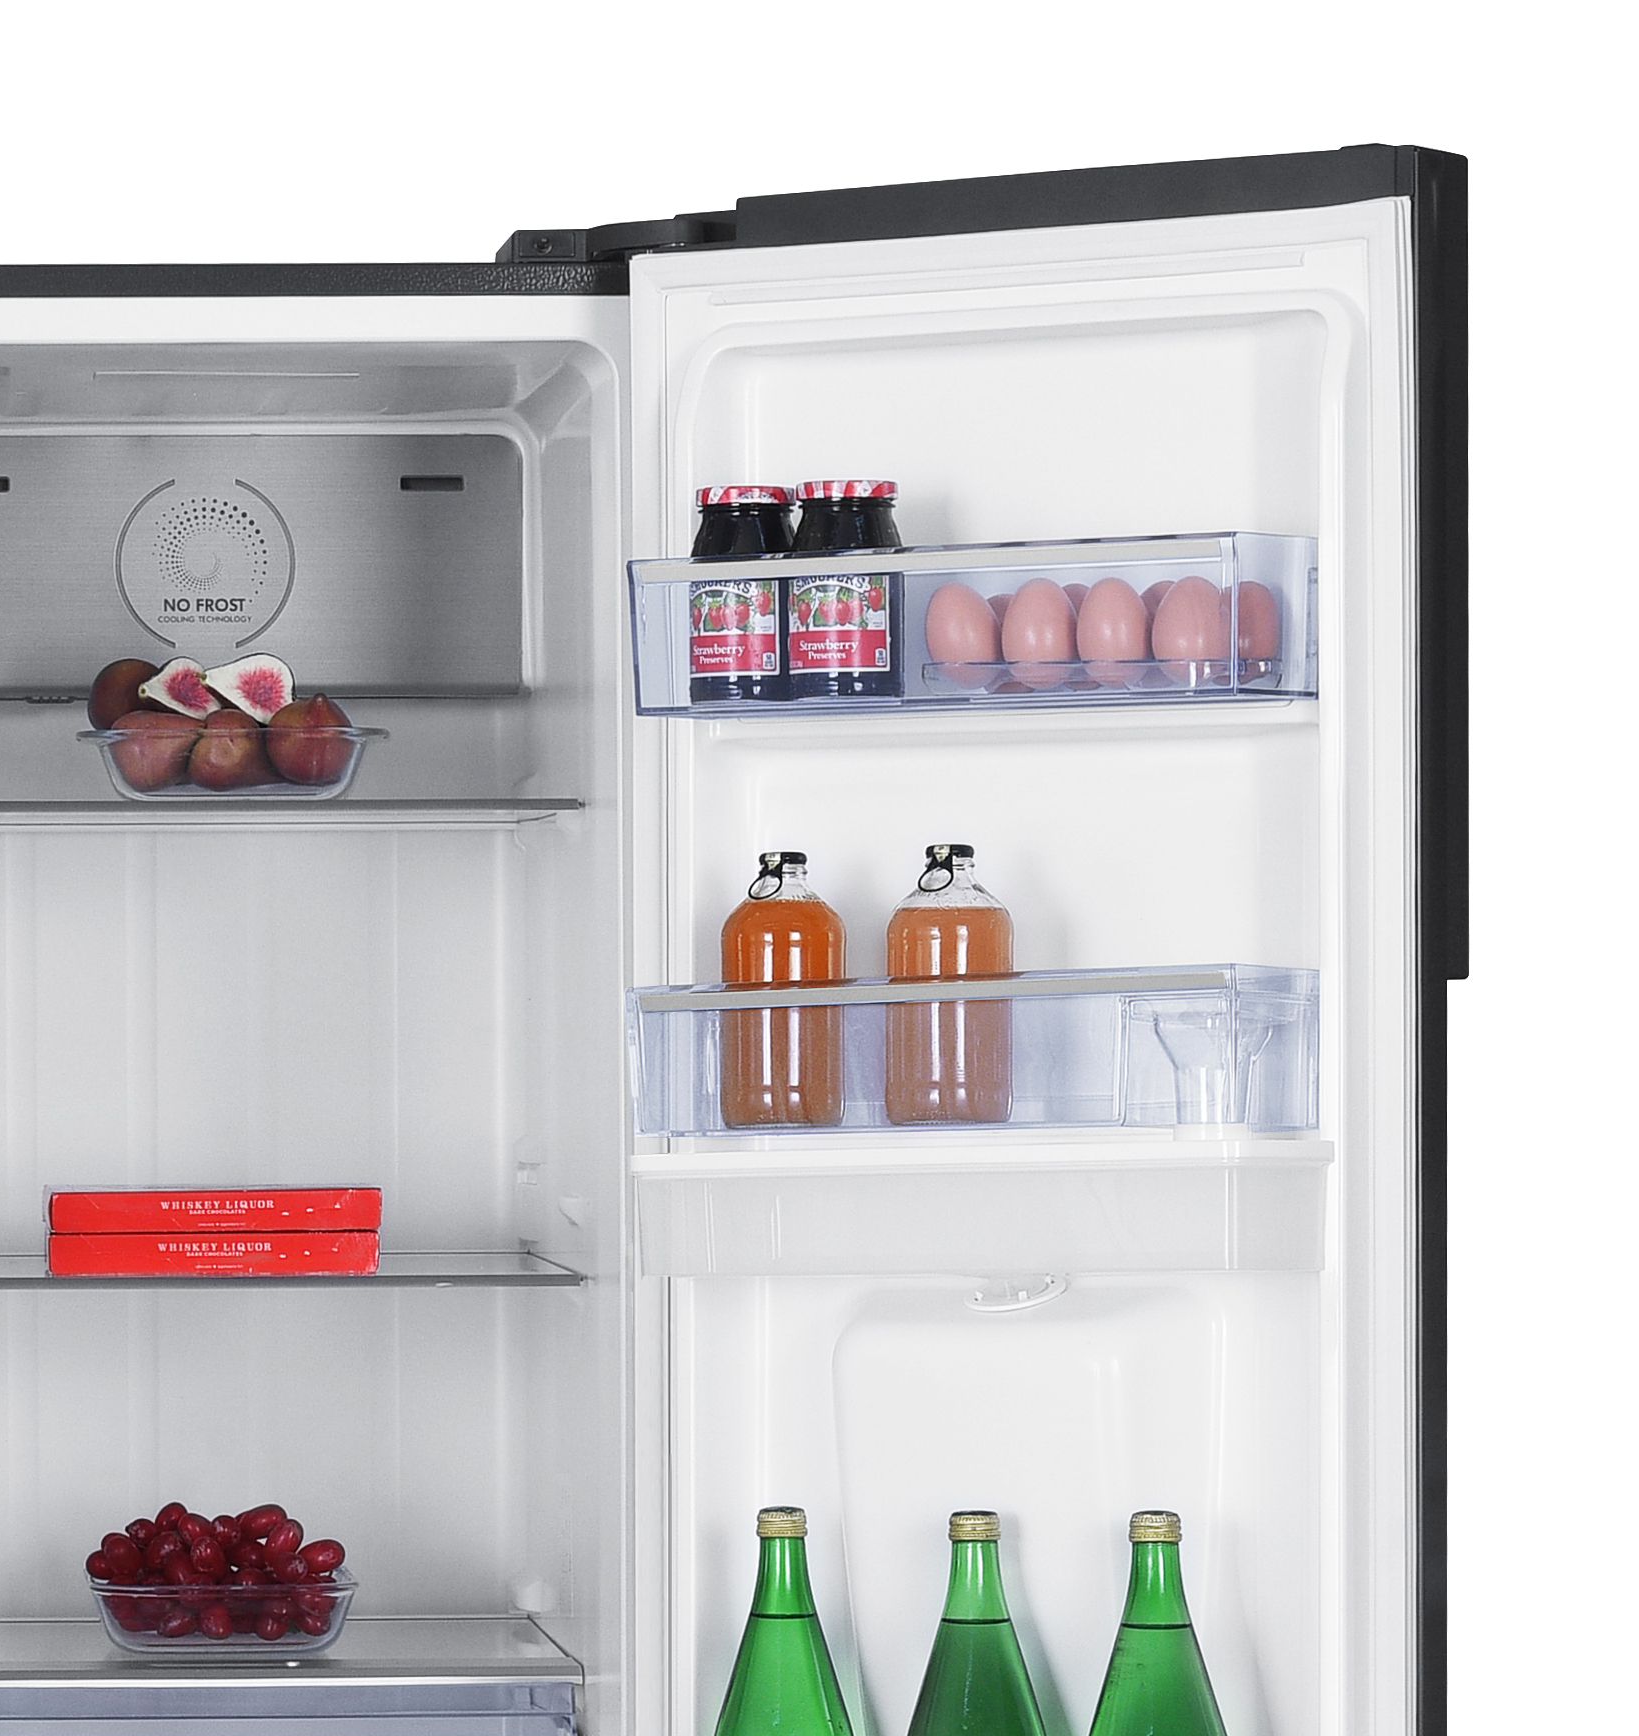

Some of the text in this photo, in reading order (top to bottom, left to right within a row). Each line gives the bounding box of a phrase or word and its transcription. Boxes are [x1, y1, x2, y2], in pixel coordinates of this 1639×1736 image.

[163, 598, 246, 612] NO FROST
[157, 615, 252, 623] COOLING TECHNOLOGY
[693, 643, 746, 657] Strawberry
[799, 639, 859, 654] Strawberry
[699, 656, 734, 664] Preserves
[808, 652, 847, 660] Preserves
[160, 1200, 275, 1210] WHISKEY LIQUOR
[157, 1242, 272, 1252] WHISKEY LIQUOR
